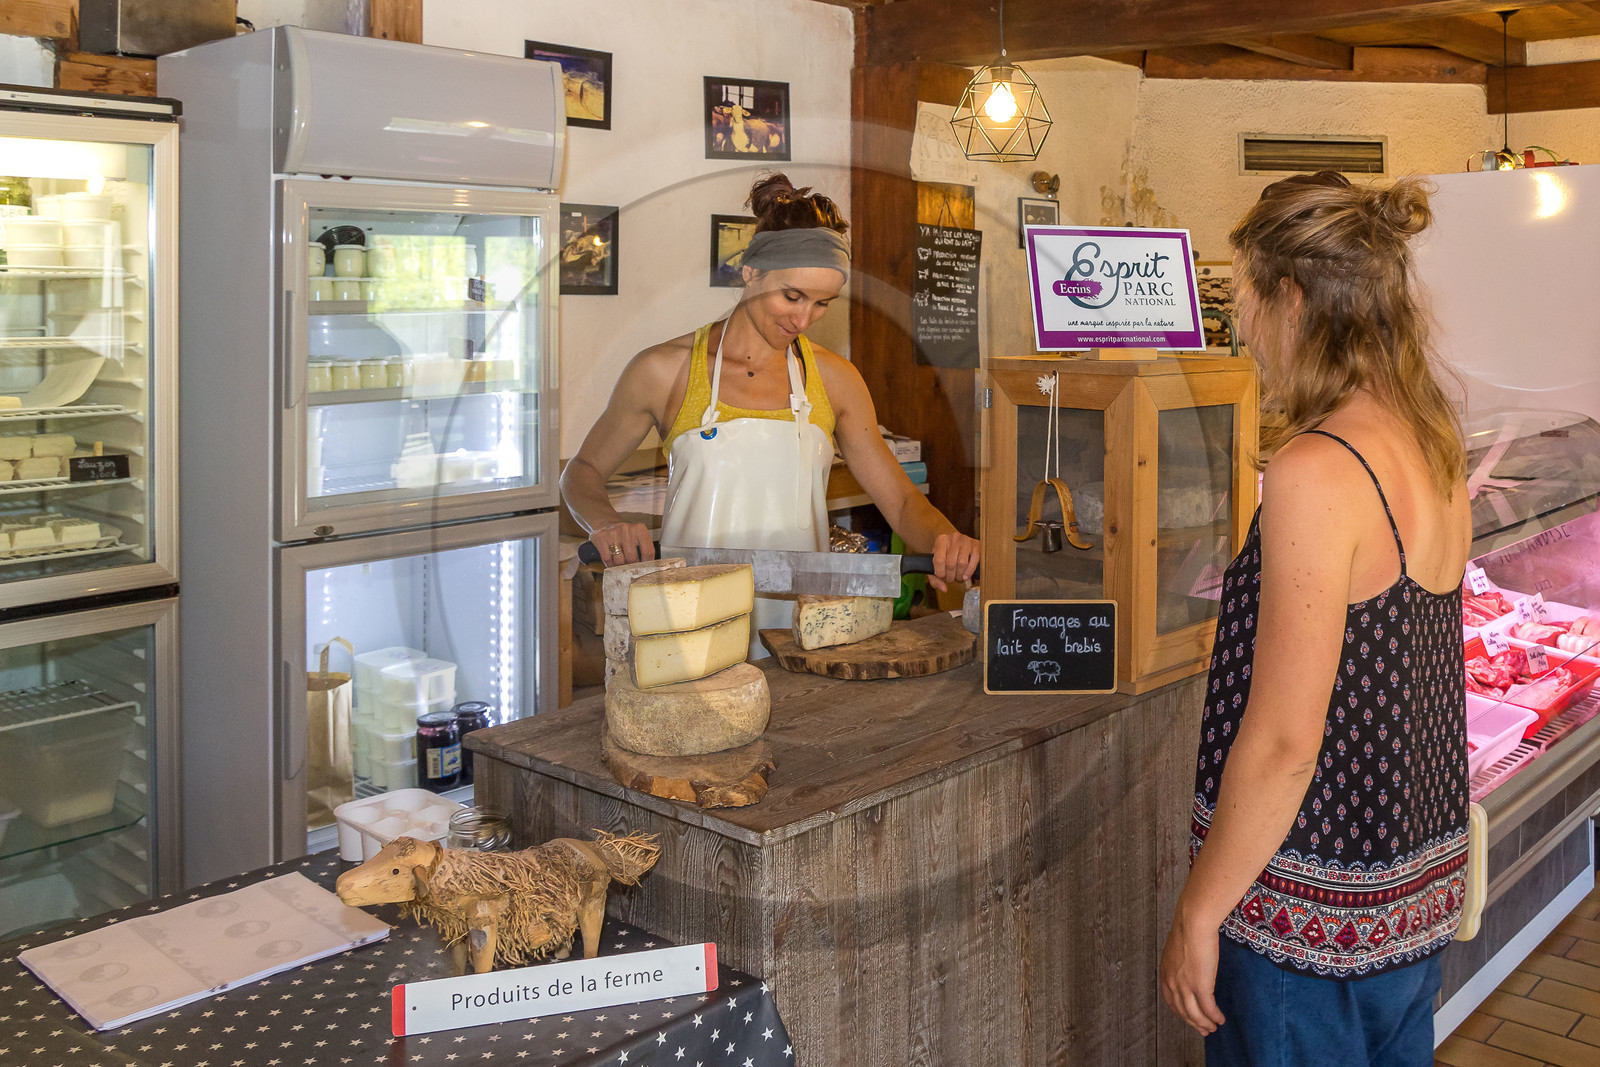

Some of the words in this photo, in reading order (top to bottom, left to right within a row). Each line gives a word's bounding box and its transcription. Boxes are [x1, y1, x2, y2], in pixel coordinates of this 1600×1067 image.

[1064, 242, 1170, 310] Esprit
[1060, 283, 1092, 295] Ecrins
[1123, 281, 1174, 296] PARC
[1125, 297, 1176, 306] NATIONAL
[1080, 320, 1104, 329] marque
[1105, 318, 1131, 329] inspirée
[1132, 320, 1144, 329] par
[1145, 318, 1153, 327] la
[1153, 318, 1175, 327] nature
[1077, 335, 1166, 344] www.espritparcnational.com
[1012, 608, 1081, 639] Fromages
[1088, 614, 1110, 628] au
[997, 637, 1023, 657] lait
[1031, 638, 1048, 654] de
[1064, 636, 1101, 653] brebis
[451, 986, 541, 1011] Produits
[548, 978, 573, 998] de
[581, 975, 597, 992] la
[604, 969, 664, 990] ferme
